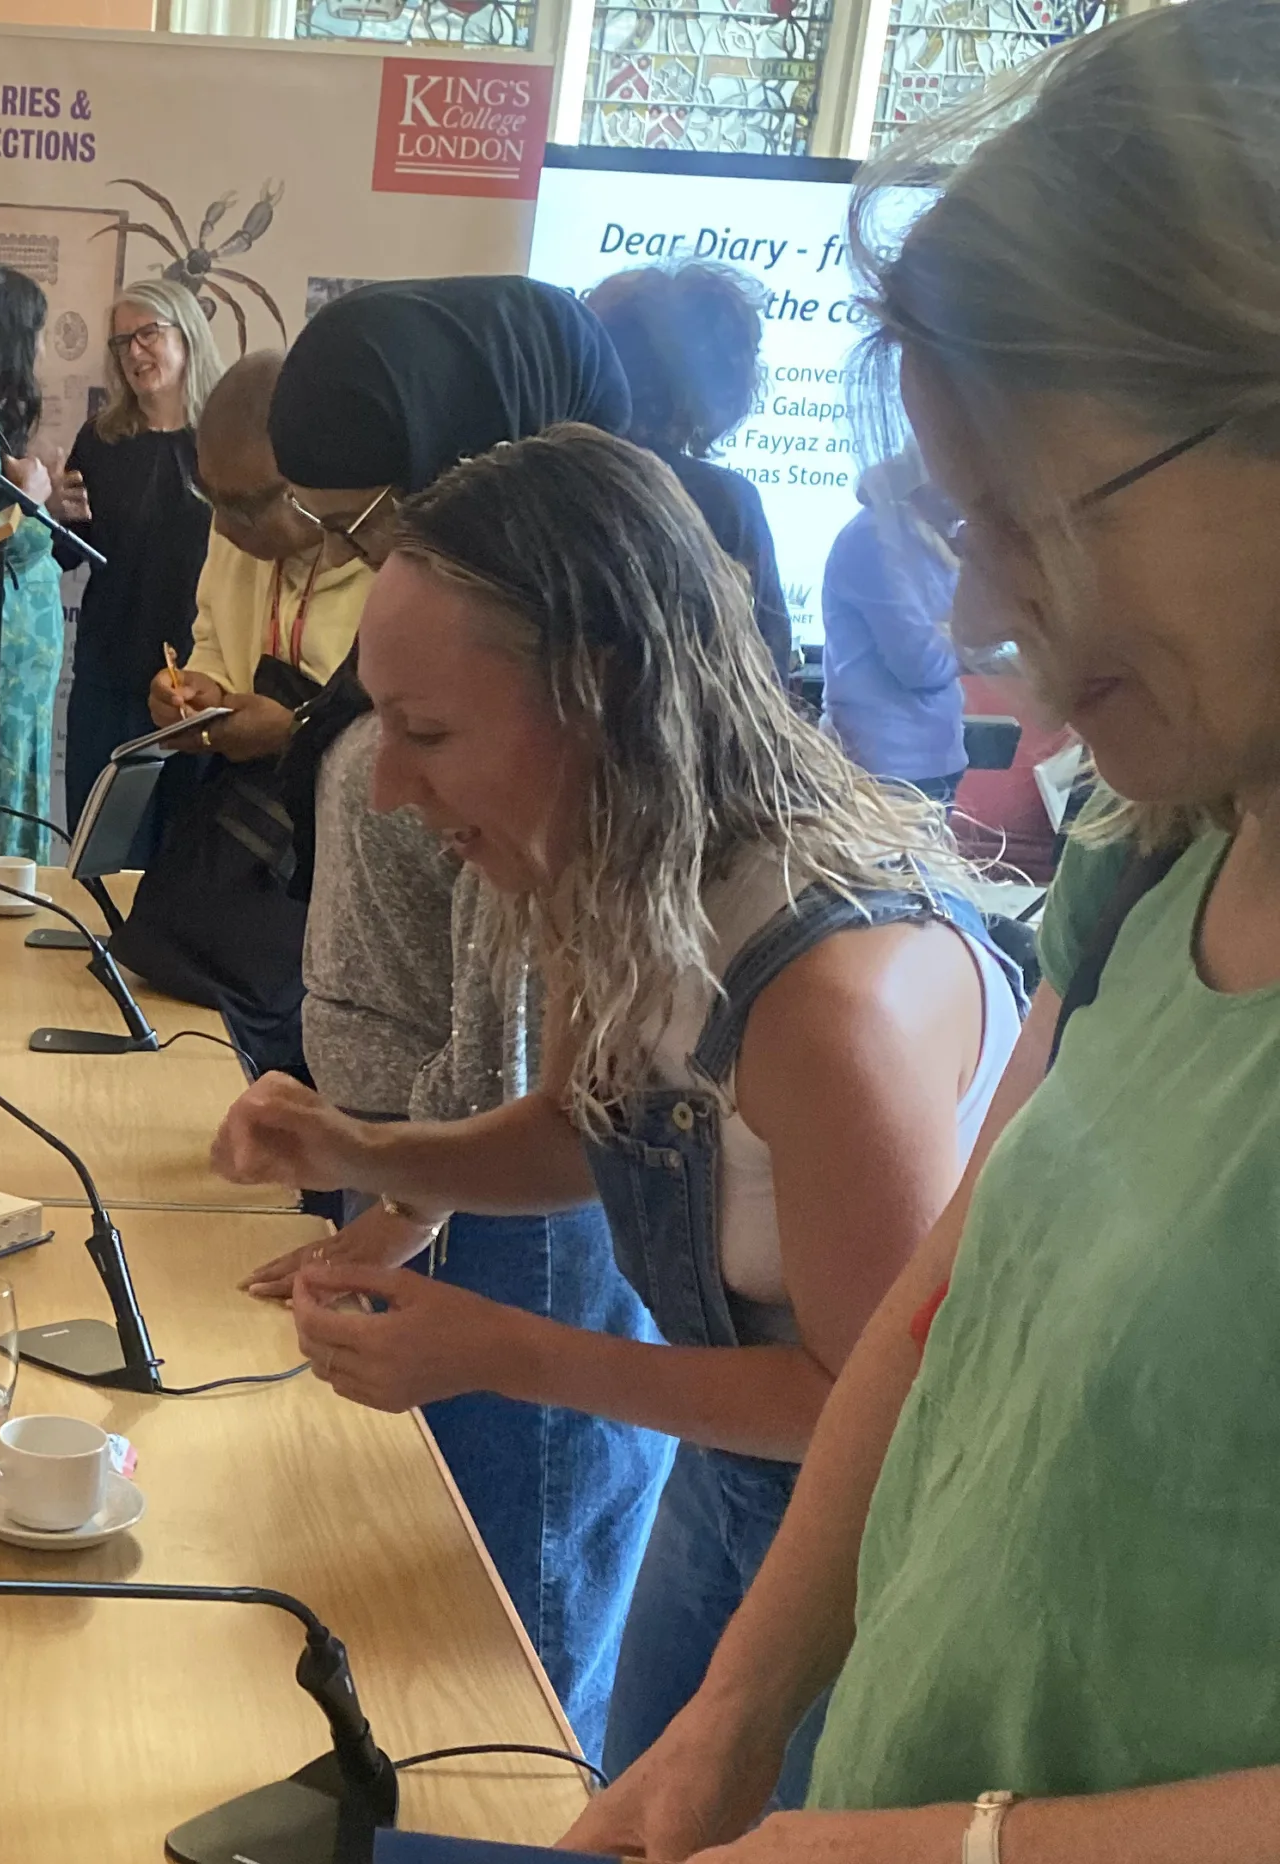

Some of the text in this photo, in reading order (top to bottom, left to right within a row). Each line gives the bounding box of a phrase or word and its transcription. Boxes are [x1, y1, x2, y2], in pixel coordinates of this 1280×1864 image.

[70, 89, 92, 120] &
[398, 74, 531, 128] KING'S
[442, 104, 527, 137] College
[397, 132, 525, 163] LONDON
[599, 222, 686, 257] Dear
[693, 226, 789, 270] Diary
[816, 233, 850, 273] fr
[764, 289, 866, 324] the co
[775, 365, 858, 385] convers
[772, 395, 856, 422] Galappa
[744, 429, 820, 455] Fayyaz
[787, 465, 850, 487] Stone
[790, 613, 814, 625] NET
